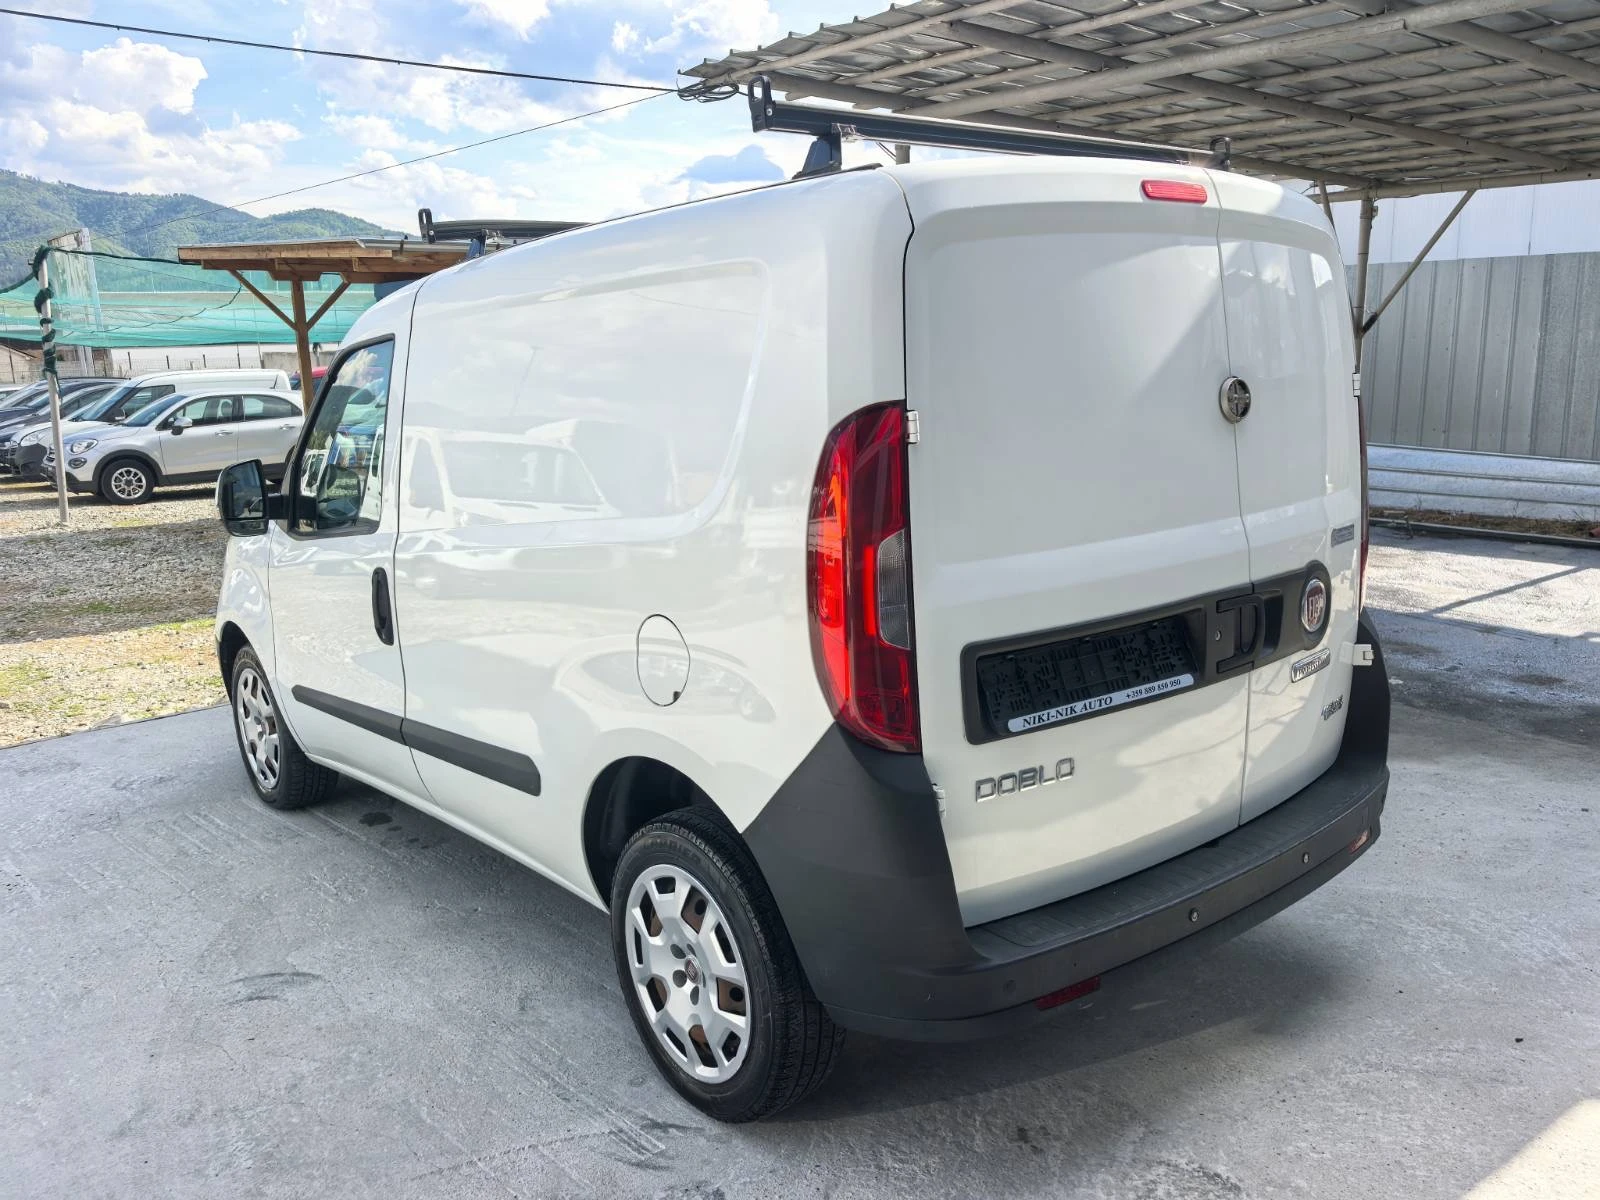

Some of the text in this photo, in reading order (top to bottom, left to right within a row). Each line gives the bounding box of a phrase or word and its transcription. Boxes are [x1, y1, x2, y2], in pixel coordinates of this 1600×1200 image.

[1023, 705, 1077, 728] NIKI-NIK
[1080, 696, 1113, 712] AUTO
[1126, 690, 1143, 699] +359
[1169, 678, 1181, 687] 950
[975, 757, 1076, 802] DOBLO
